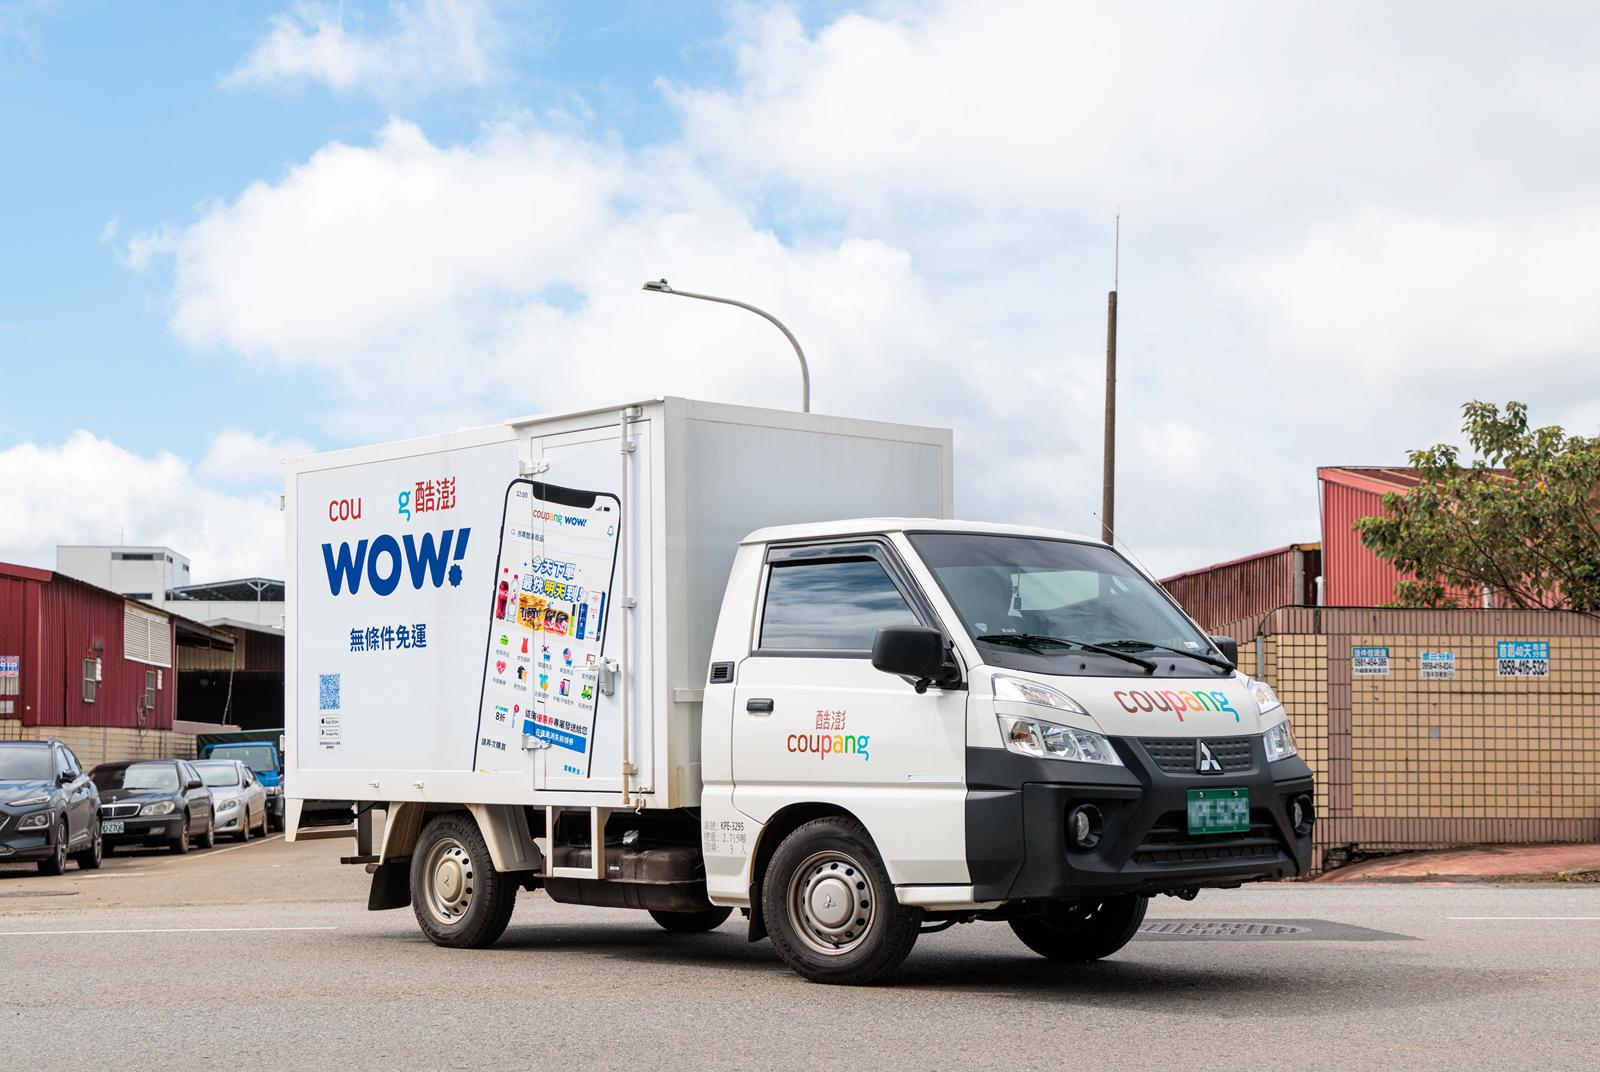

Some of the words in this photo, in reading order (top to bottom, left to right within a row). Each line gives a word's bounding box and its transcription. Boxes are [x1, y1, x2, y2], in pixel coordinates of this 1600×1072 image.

[415, 476, 456, 513] 酷澎
[532, 509, 563, 526] coupang
[564, 515, 587, 527] WOW!
[321, 527, 471, 597] WOW!
[532, 554, 576, 581] 今天下單
[350, 623, 427, 652] 無條件免運
[815, 709, 846, 730] 酷澎
[1113, 690, 1240, 722] coupang
[787, 734, 870, 761] coupang
